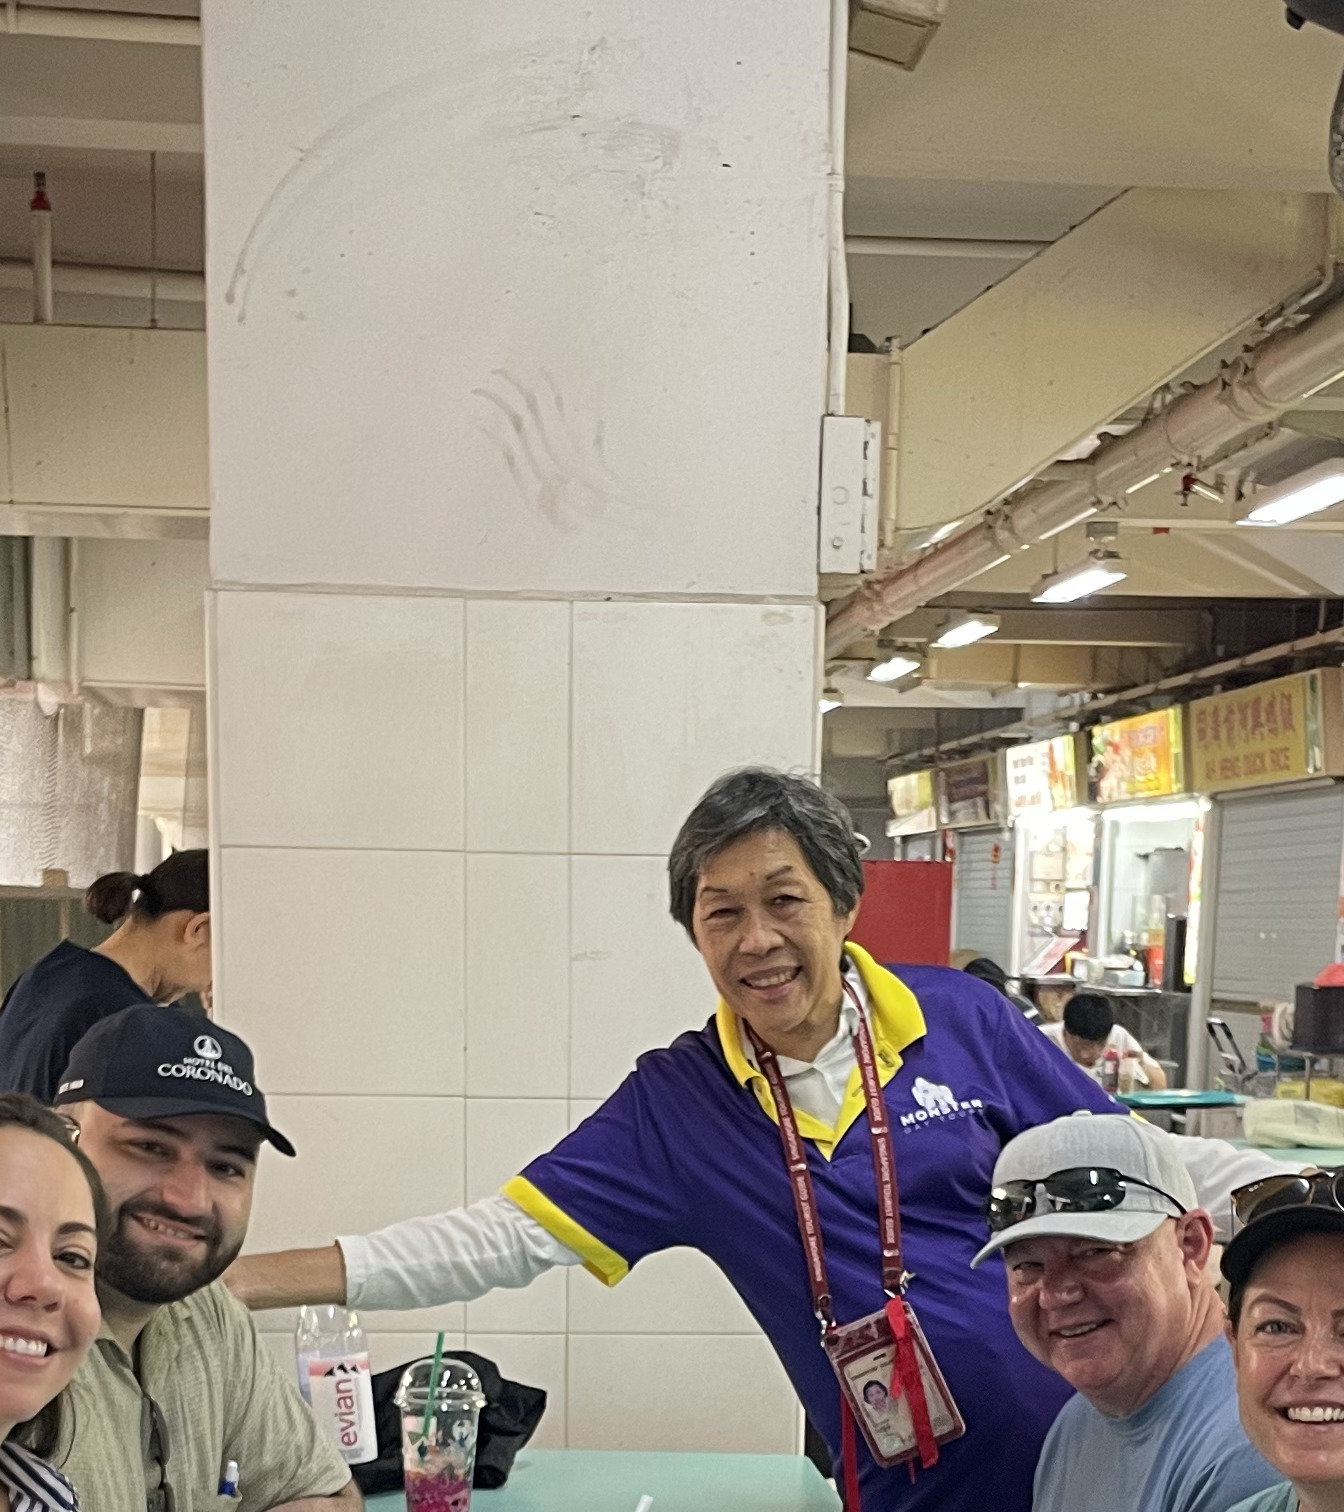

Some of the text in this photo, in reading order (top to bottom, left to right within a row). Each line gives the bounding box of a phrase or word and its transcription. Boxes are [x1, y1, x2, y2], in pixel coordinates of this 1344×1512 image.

[157, 1063, 253, 1096] CORONADO
[183, 1057, 234, 1075] HOTEL DEL
[870, 1097, 882, 1121] GUIDE
[900, 1099, 983, 1127] MONSTER
[796, 1175, 809, 1201] GUIDE
[882, 1184, 893, 1216] TOURIST
[801, 1200, 815, 1235] TOURIST
[885, 1218, 895, 1244] GUIDE
[334, 1377, 358, 1448] evian
